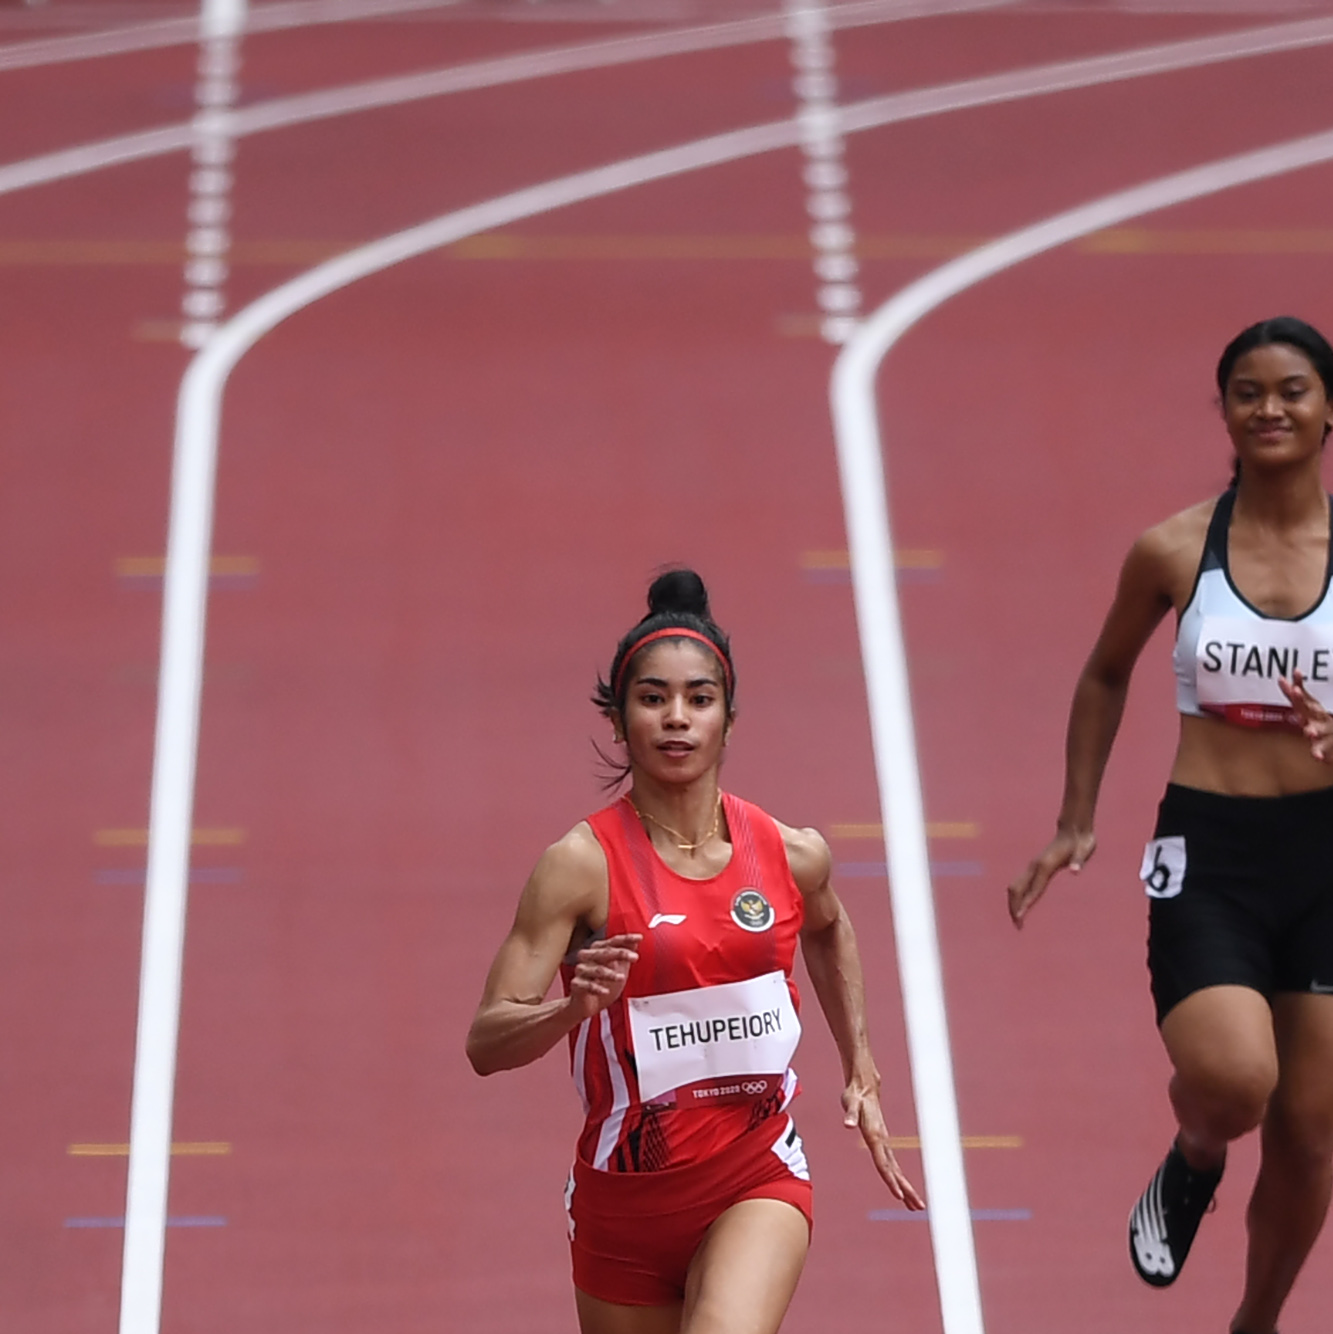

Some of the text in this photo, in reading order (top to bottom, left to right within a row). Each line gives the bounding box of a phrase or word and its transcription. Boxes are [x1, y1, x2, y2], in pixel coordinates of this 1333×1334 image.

[1148, 845, 1171, 892] 6
[649, 1007, 783, 1051] TEHUPEIORY
[692, 1088, 719, 1098] TOKYO
